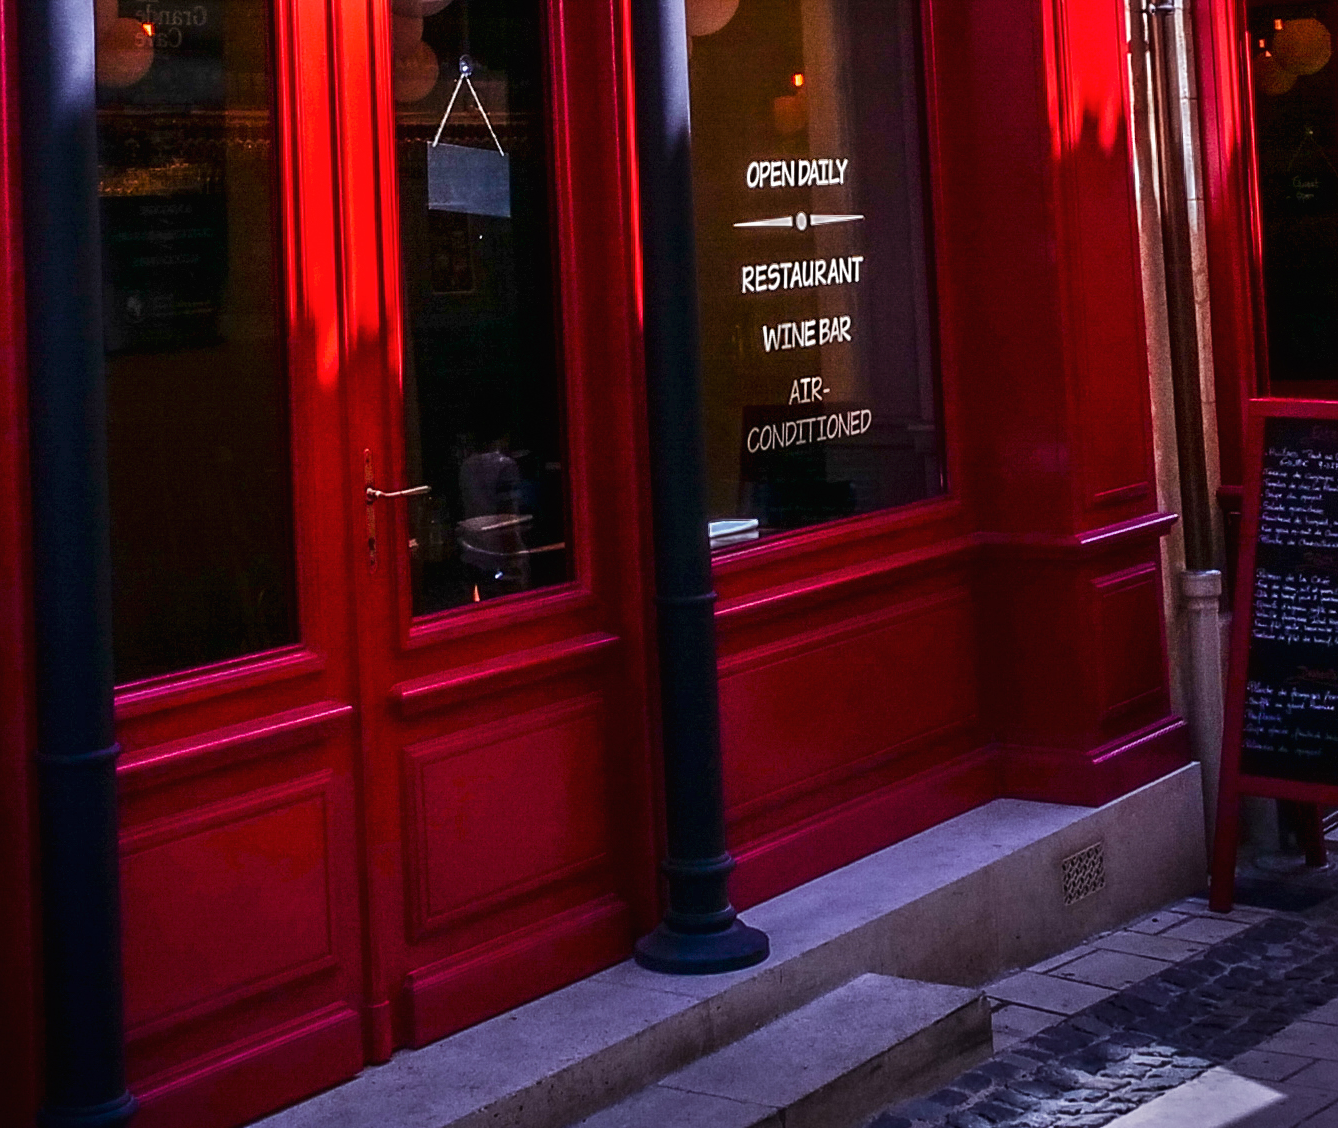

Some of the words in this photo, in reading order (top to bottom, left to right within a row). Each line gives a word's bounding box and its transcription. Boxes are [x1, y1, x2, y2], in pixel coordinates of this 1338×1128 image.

[746, 159, 796, 189] OPEN
[797, 158, 849, 186] DAILY
[741, 256, 864, 294] RESTAURANT
[762, 320, 816, 353] WINE
[819, 315, 852, 345] BAR
[789, 377, 831, 406] AIR-
[747, 408, 872, 454] CONDITIONED
